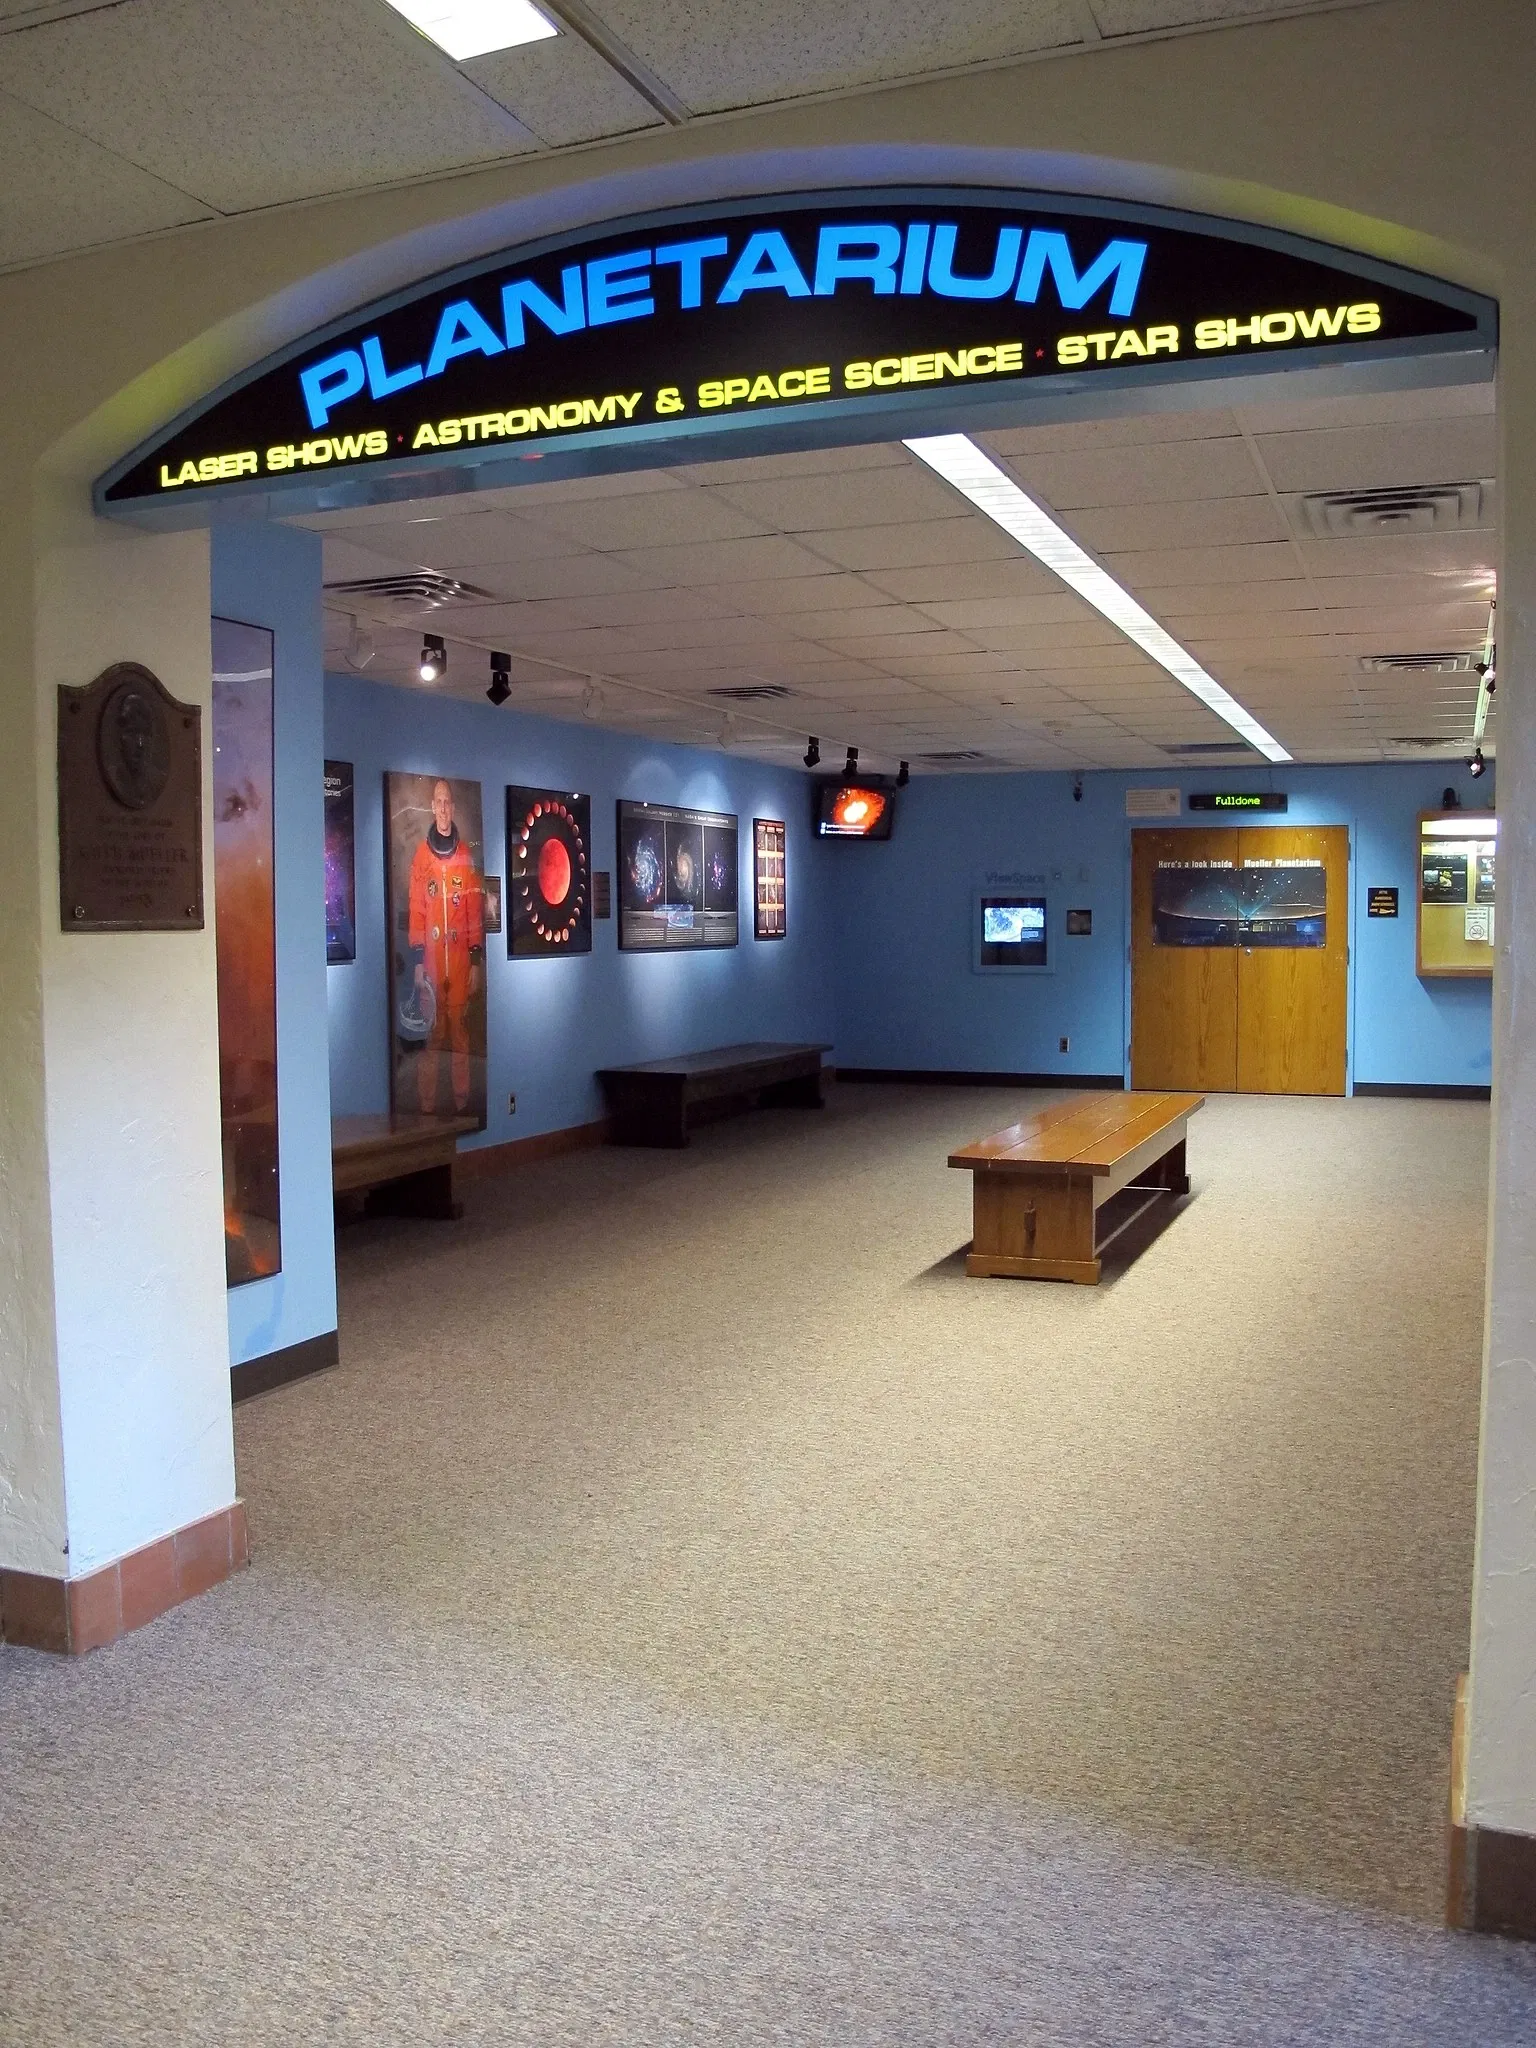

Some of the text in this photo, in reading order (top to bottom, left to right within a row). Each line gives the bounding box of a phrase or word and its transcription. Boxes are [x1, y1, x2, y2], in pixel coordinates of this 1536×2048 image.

[300, 224, 1148, 430] PLANETARIUM
[160, 302, 1382, 489] LASER SHOWS ASTRONOMY & SPACE SCIENCE STAR SHOWS
[1215, 796, 1261, 806] Fulldome
[1158, 860, 1182, 868] Here's
[1244, 859, 1273, 868] Mueller
[1275, 859, 1321, 868] Planetarium
